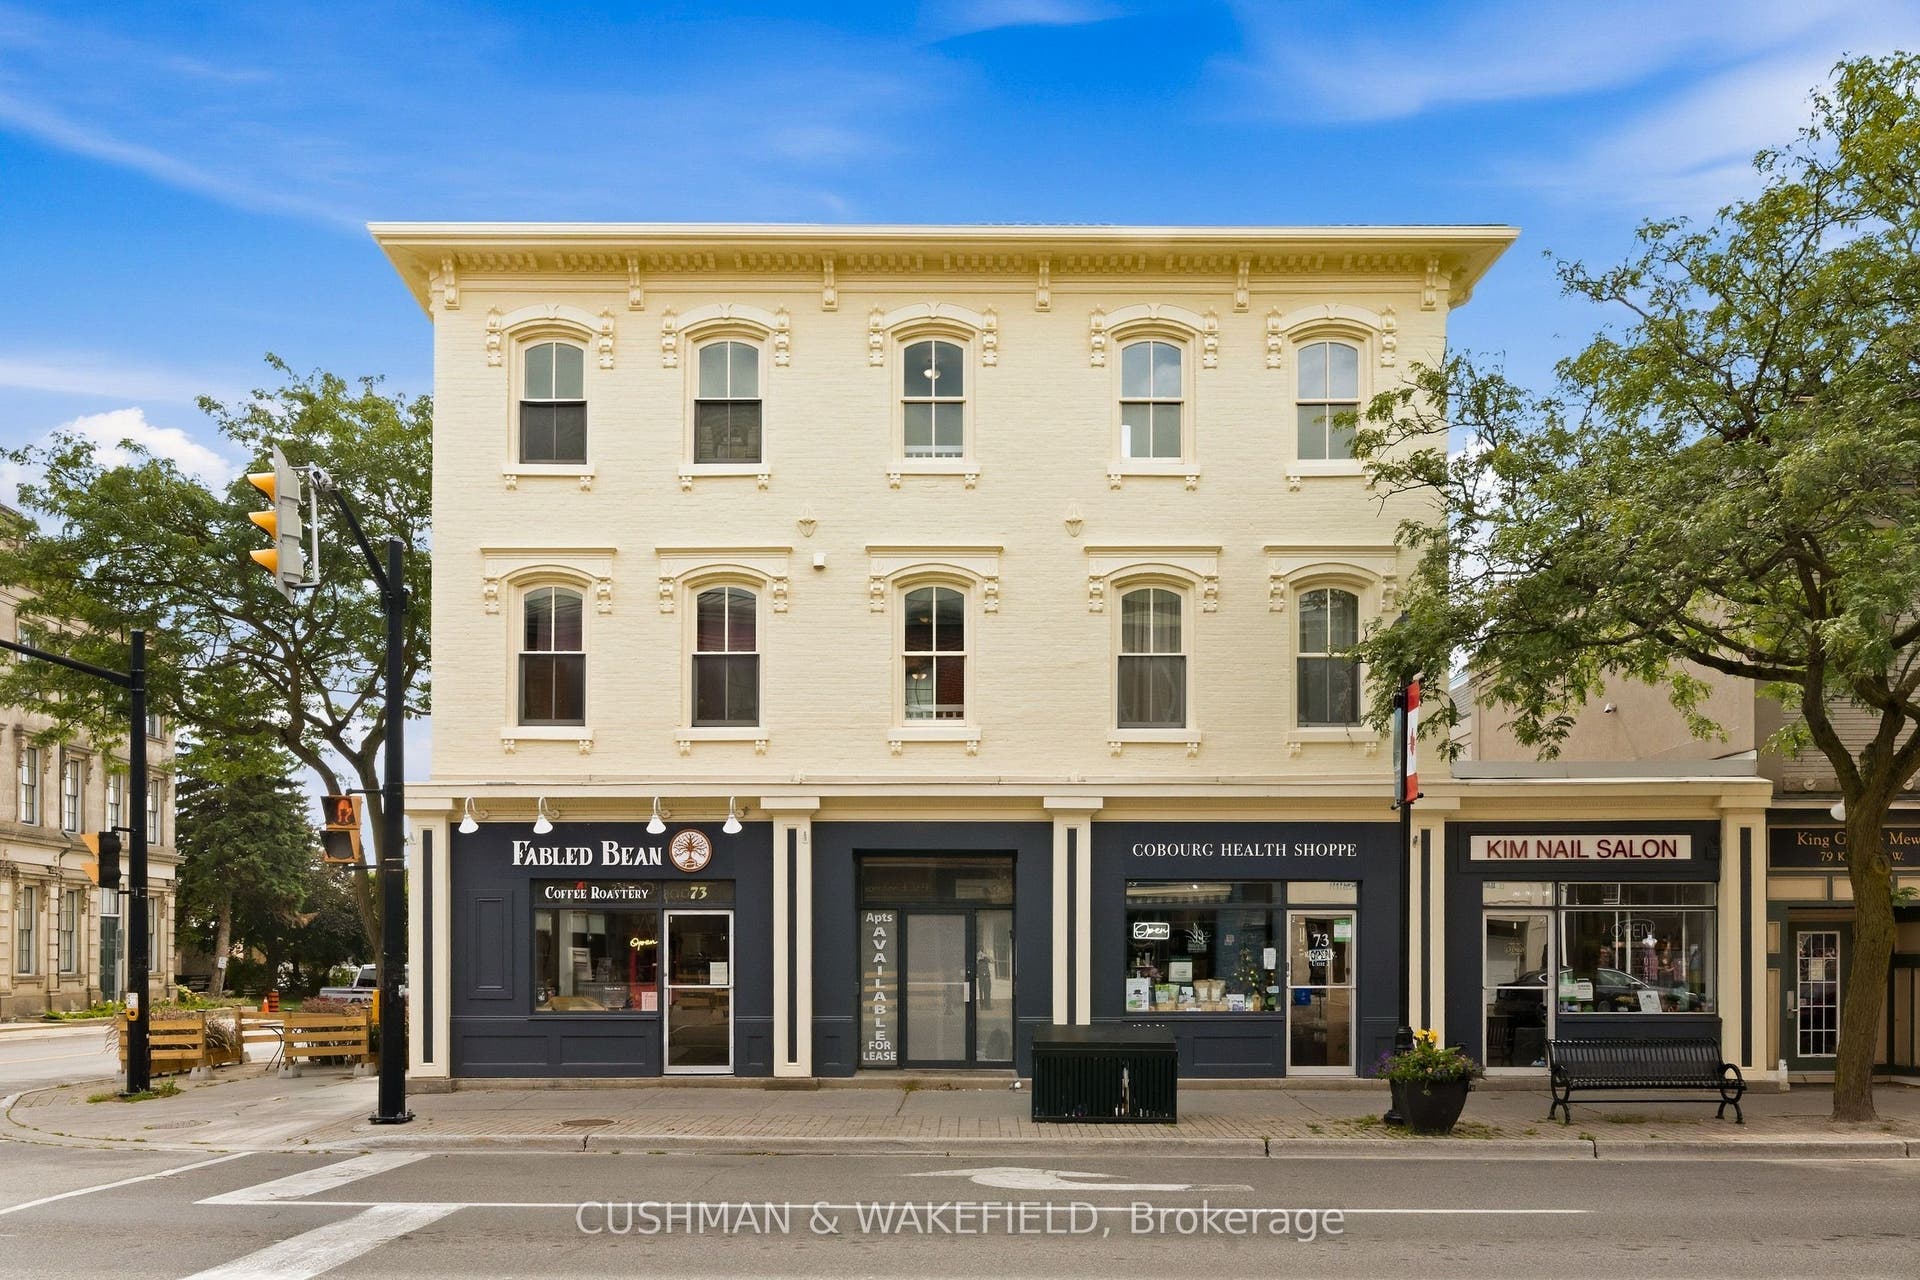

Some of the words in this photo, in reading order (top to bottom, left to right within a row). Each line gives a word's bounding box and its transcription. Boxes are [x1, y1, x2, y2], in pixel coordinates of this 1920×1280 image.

[1797, 831, 1829, 848] King
[512, 840, 593, 866] FABLED
[601, 840, 663, 866] BEAN
[1132, 843, 1213, 857] COBOURG
[1221, 843, 1287, 857] HEALTH
[1294, 843, 1357, 857] SHOPPE
[1487, 840, 1528, 858] KIM
[1536, 840, 1589, 858] NAIL
[1596, 839, 1677, 859] SALON
[1820, 851, 1833, 862] 79
[544, 886, 588, 899] COFFEE
[591, 886, 649, 899] ROASTERY
[690, 886, 708, 899] 73
[866, 912, 893, 924] Apts
[1135, 923, 1169, 938] Open
[1610, 923, 1653, 938] OPEN
[629, 937, 658, 951] Open
[1313, 933, 1330, 947] 73
[872, 926, 887, 1041] AVAILABLE
[868, 1041, 891, 1050] FOR
[863, 1051, 897, 1061] LEASE
